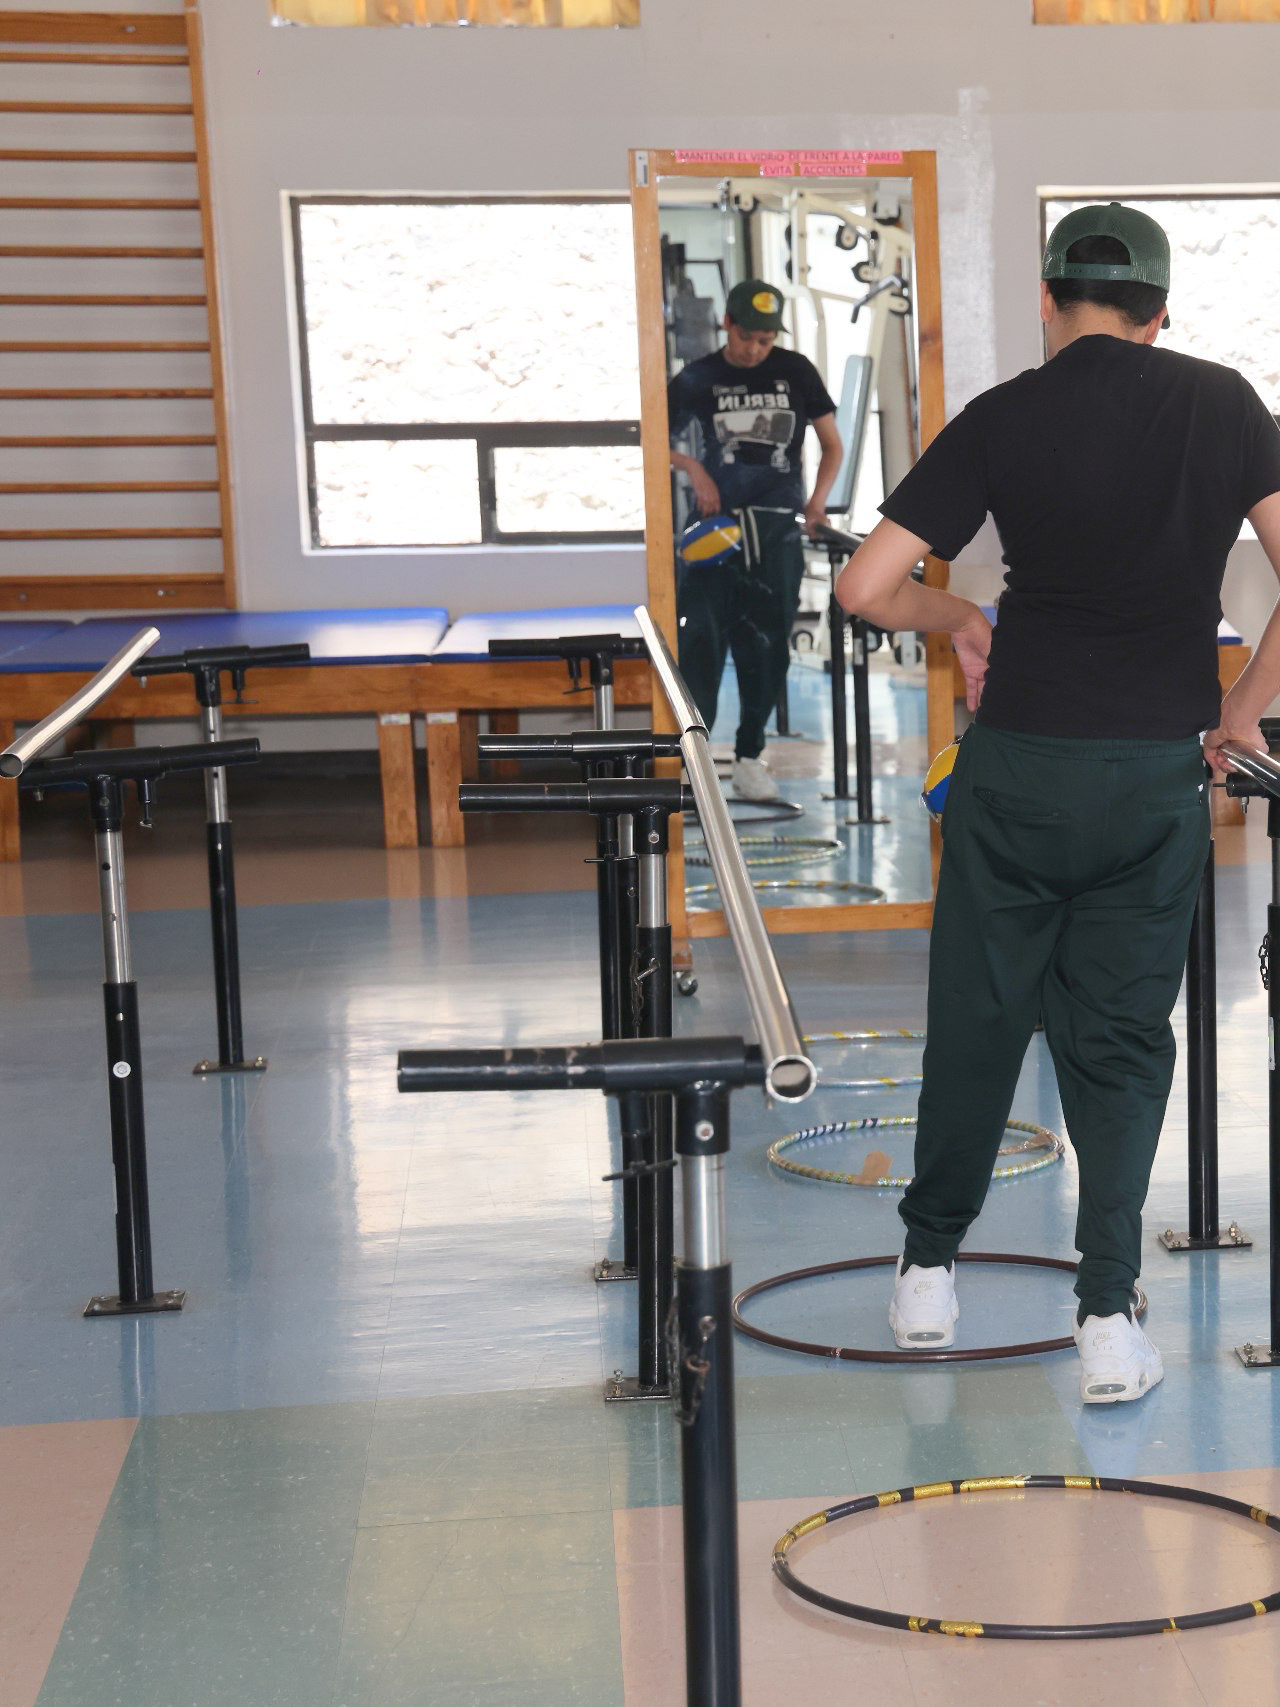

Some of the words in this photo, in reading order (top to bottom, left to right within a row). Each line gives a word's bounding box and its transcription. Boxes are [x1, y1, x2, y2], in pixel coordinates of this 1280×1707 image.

[680, 151, 735, 161] MANTENER
[738, 152, 747, 161] EL
[751, 152, 784, 162] VIDRIO
[788, 152, 800, 161] DE
[804, 152, 838, 161] FRENTE
[843, 152, 851, 161] A
[853, 152, 864, 161] LA
[868, 152, 901, 161] PARED
[803, 166, 863, 175] ACCIDENTES
